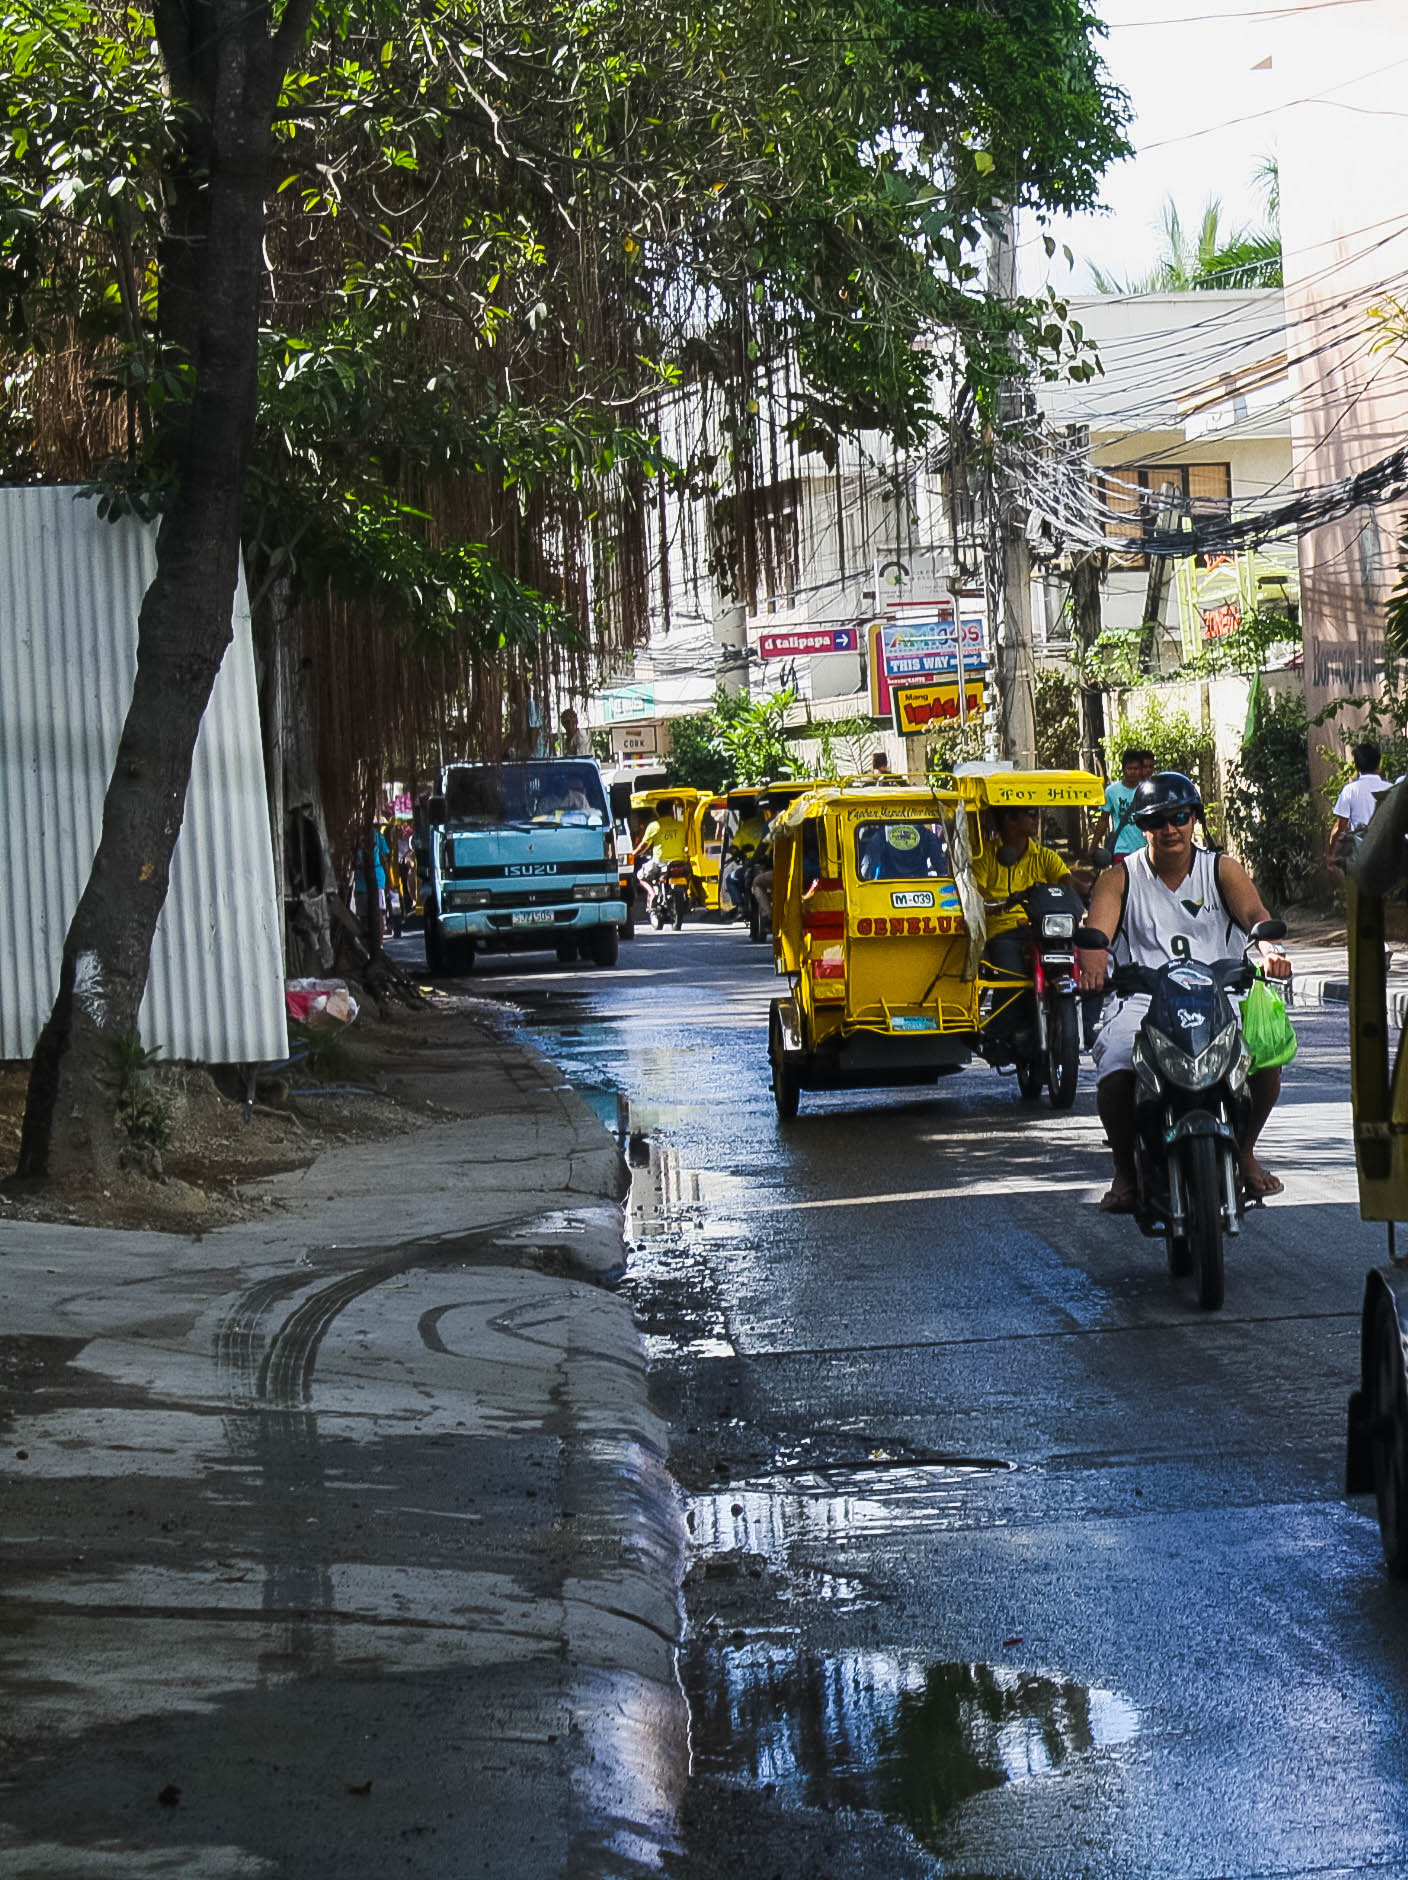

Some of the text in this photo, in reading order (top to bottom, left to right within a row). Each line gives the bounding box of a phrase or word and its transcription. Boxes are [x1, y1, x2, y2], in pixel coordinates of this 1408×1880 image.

[776, 636, 831, 650] talipapa
[890, 656, 949, 673] THIS WAY
[999, 785, 1092, 802] For Hire
[504, 863, 557, 876] ISUZU
[1170, 934, 1192, 960] 9
